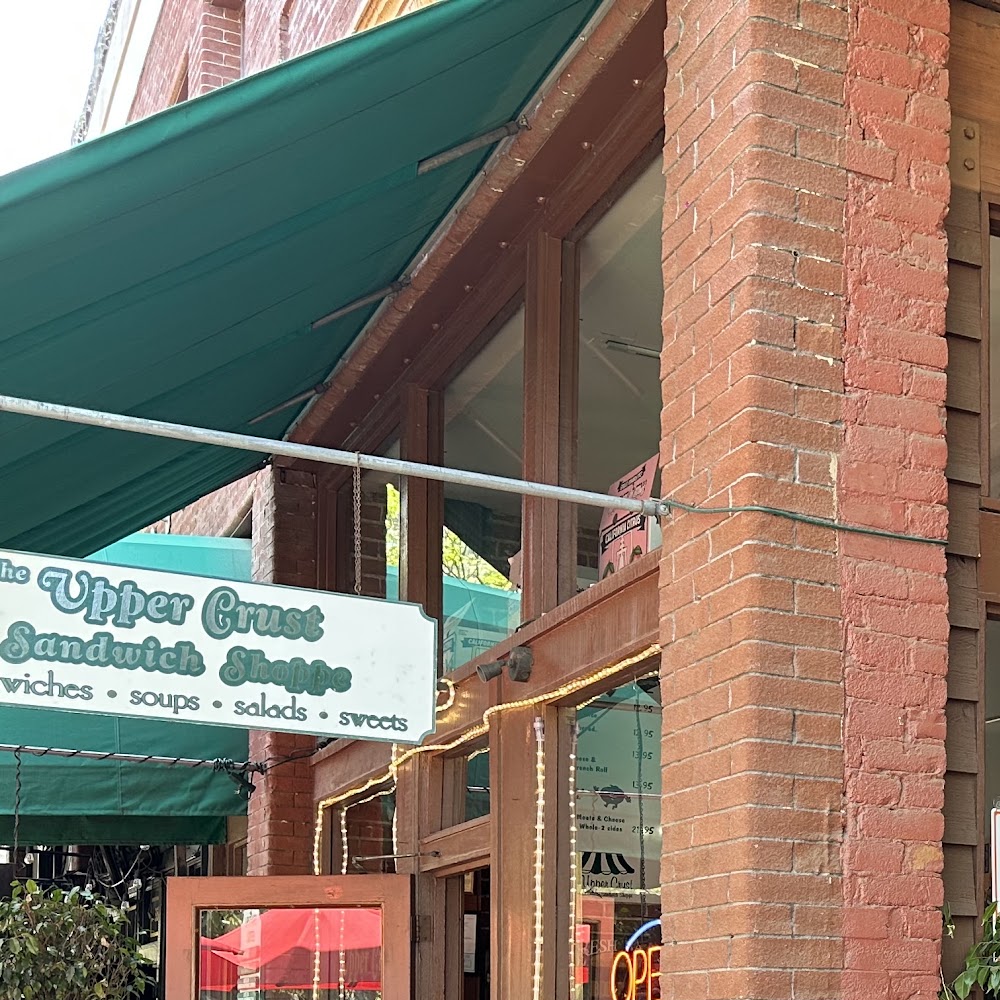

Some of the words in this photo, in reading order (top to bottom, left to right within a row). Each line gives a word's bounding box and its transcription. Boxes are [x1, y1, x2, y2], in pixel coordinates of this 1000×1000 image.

[37, 566, 195, 629] Upper
[201, 586, 325, 642] Crust
[0, 621, 206, 676] Sandwich
[219, 646, 352, 696] Shoppe
[129, 687, 201, 714] soups
[233, 692, 308, 723] salads
[338, 709, 409, 732] sweets
